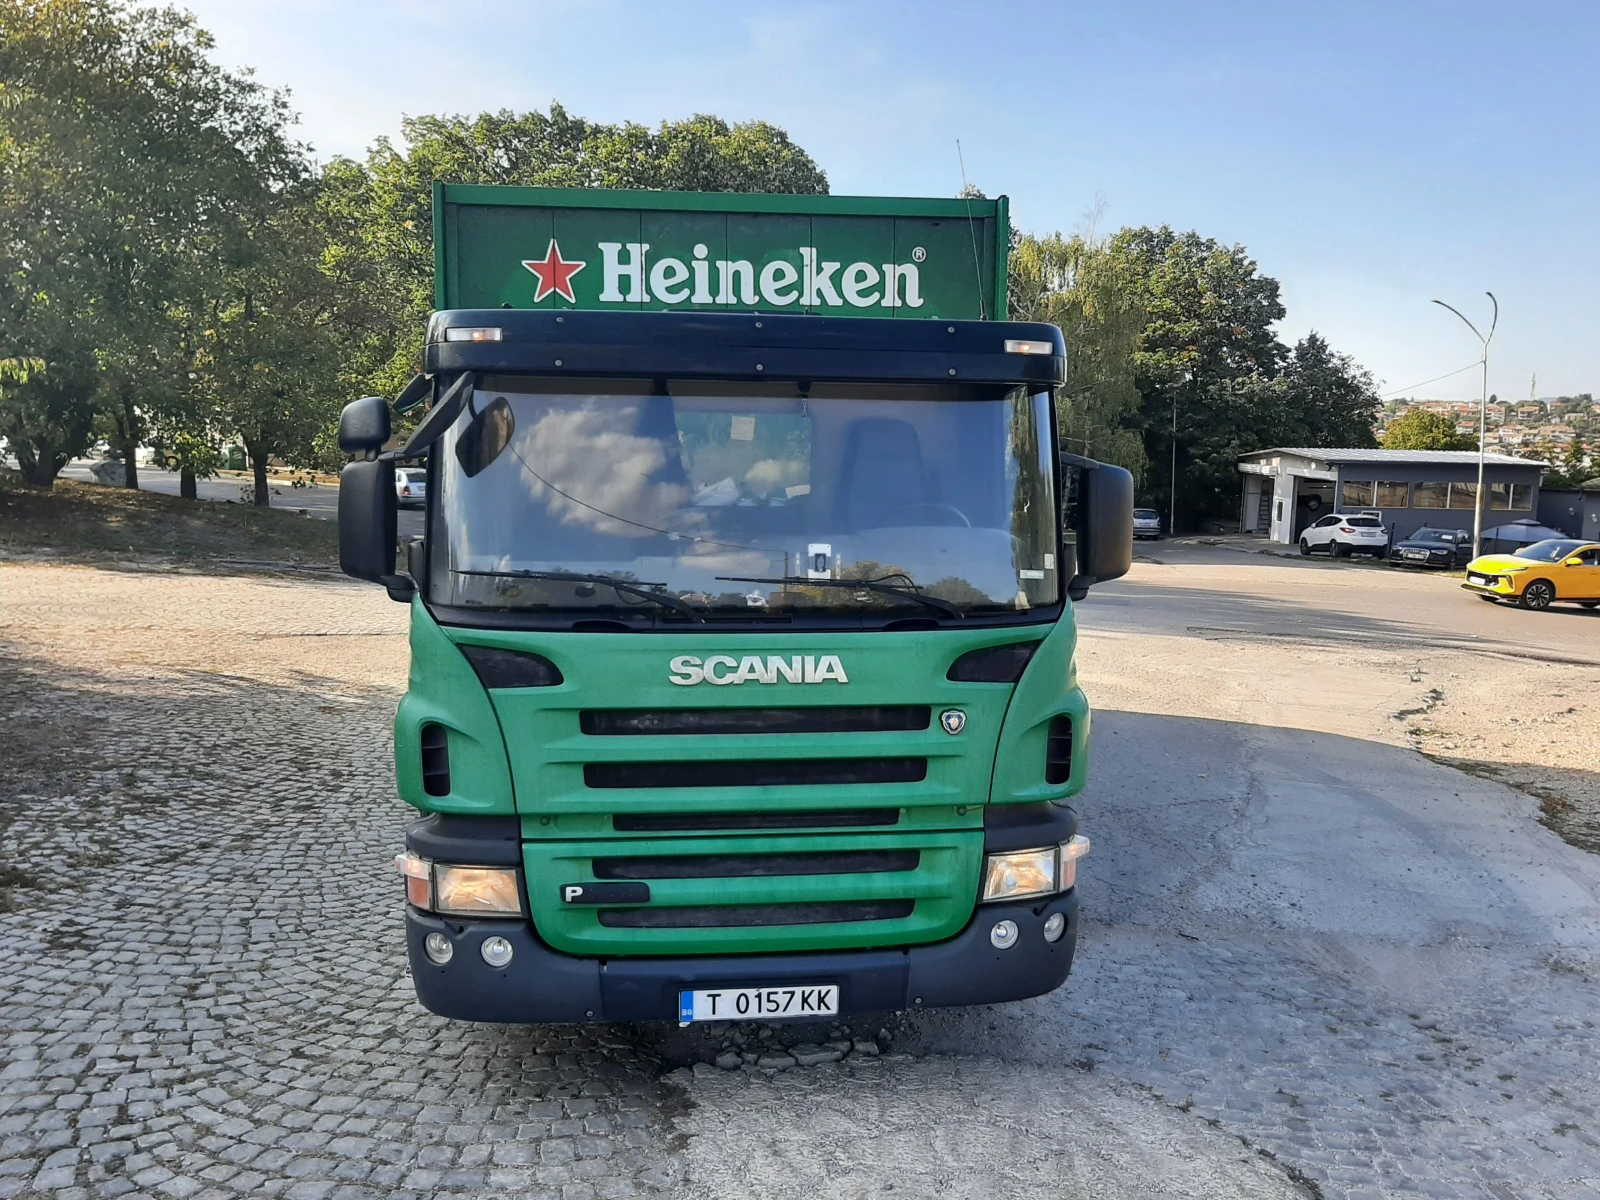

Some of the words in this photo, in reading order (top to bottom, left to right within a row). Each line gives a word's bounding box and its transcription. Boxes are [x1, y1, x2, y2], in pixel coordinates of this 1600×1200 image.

[668, 654, 848, 685] SCANIA
[565, 886, 584, 902] P
[706, 993, 722, 1016] T
